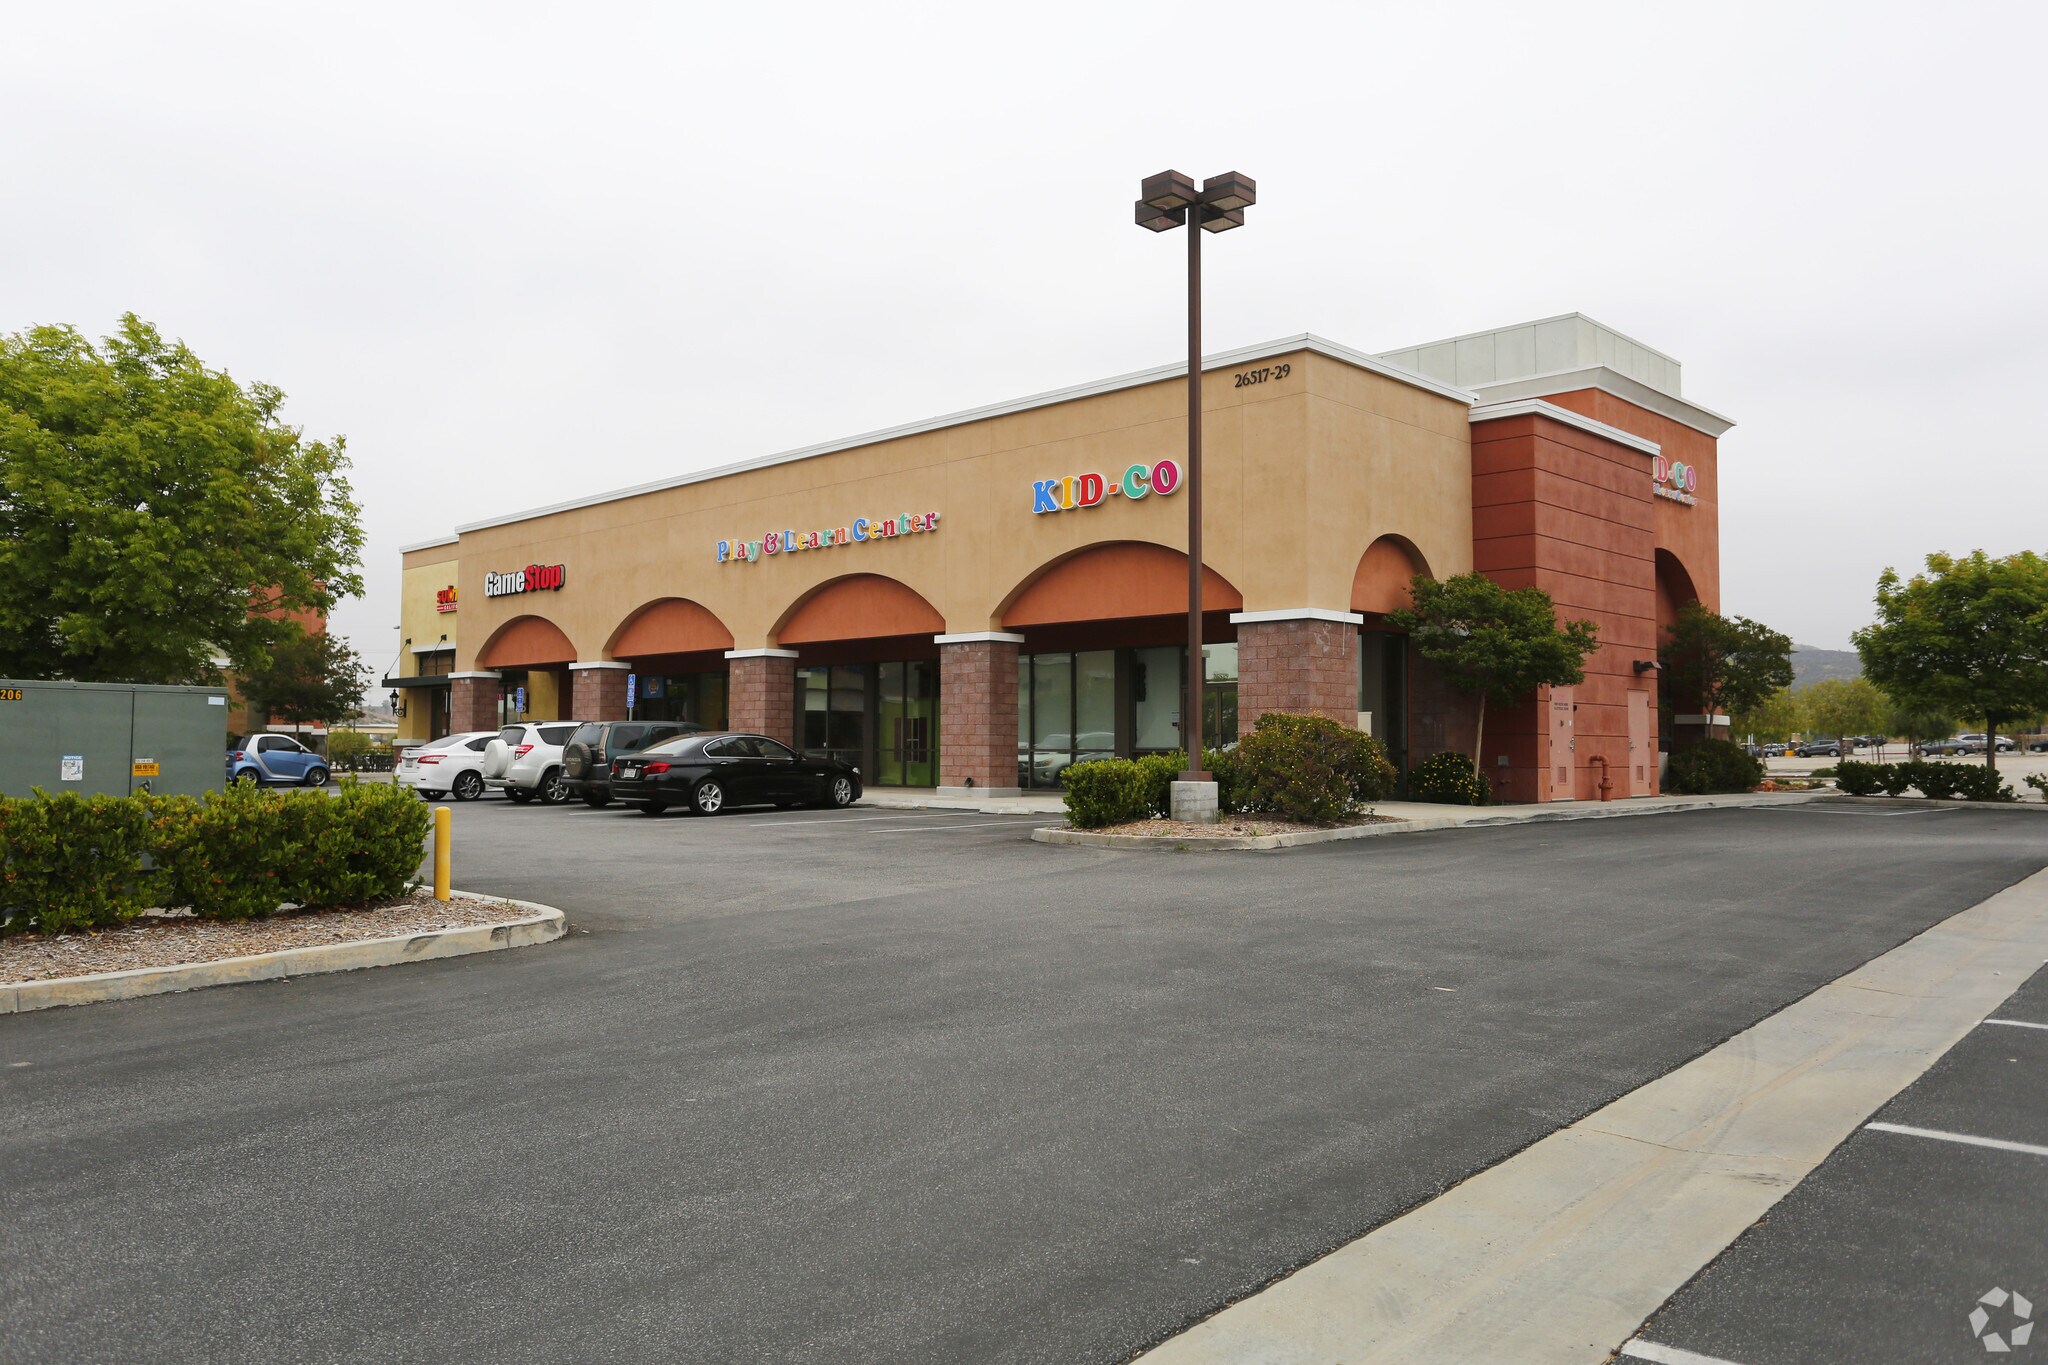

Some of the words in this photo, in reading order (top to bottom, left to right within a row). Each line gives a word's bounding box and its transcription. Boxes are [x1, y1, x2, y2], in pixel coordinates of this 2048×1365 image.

[1235, 364, 1291, 388] 26517-29
[1032, 459, 1182, 513] KID-CO
[717, 539, 760, 562] Play
[763, 532, 782, 555] &
[783, 529, 850, 553] Learn
[852, 512, 940, 542] Center
[484, 564, 565, 597] GameStop
[0, 689, 22, 700] 206
